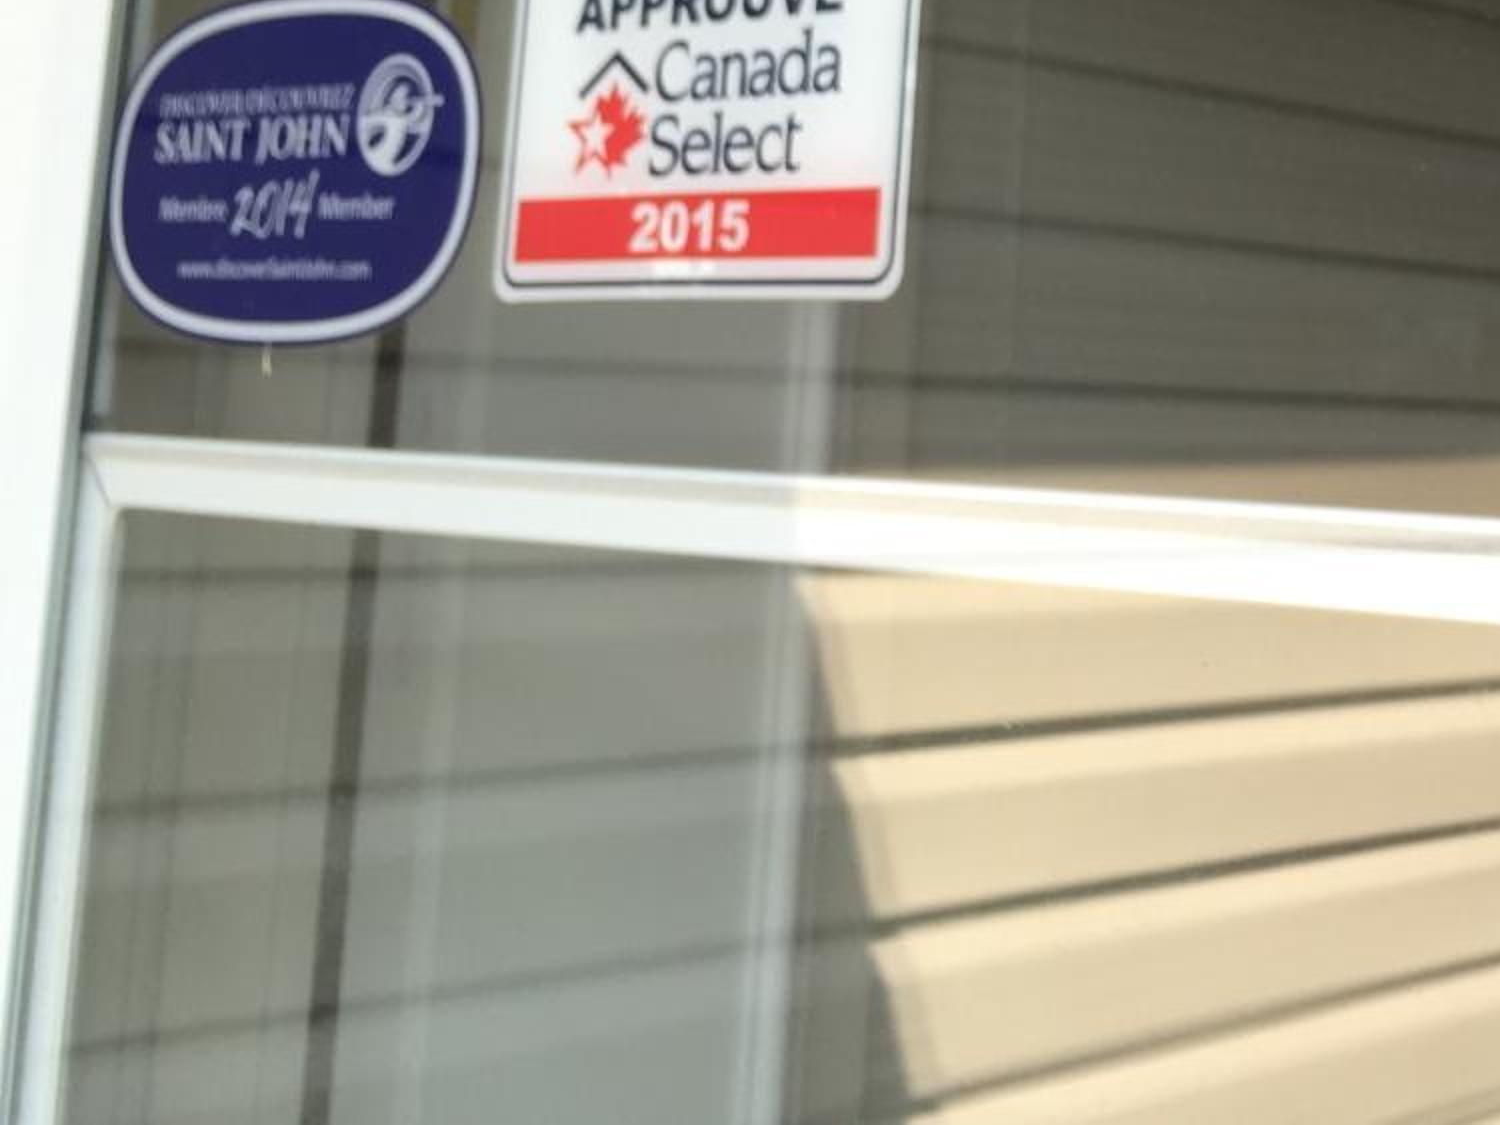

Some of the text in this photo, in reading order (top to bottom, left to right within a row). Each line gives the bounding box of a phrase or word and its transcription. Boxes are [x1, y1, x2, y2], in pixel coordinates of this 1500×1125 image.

[655, 28, 842, 102] Canada
[154, 112, 351, 165] SAINT JOHN
[648, 111, 801, 178] Select
[230, 169, 320, 238] 2014
[629, 200, 750, 253] 2015
